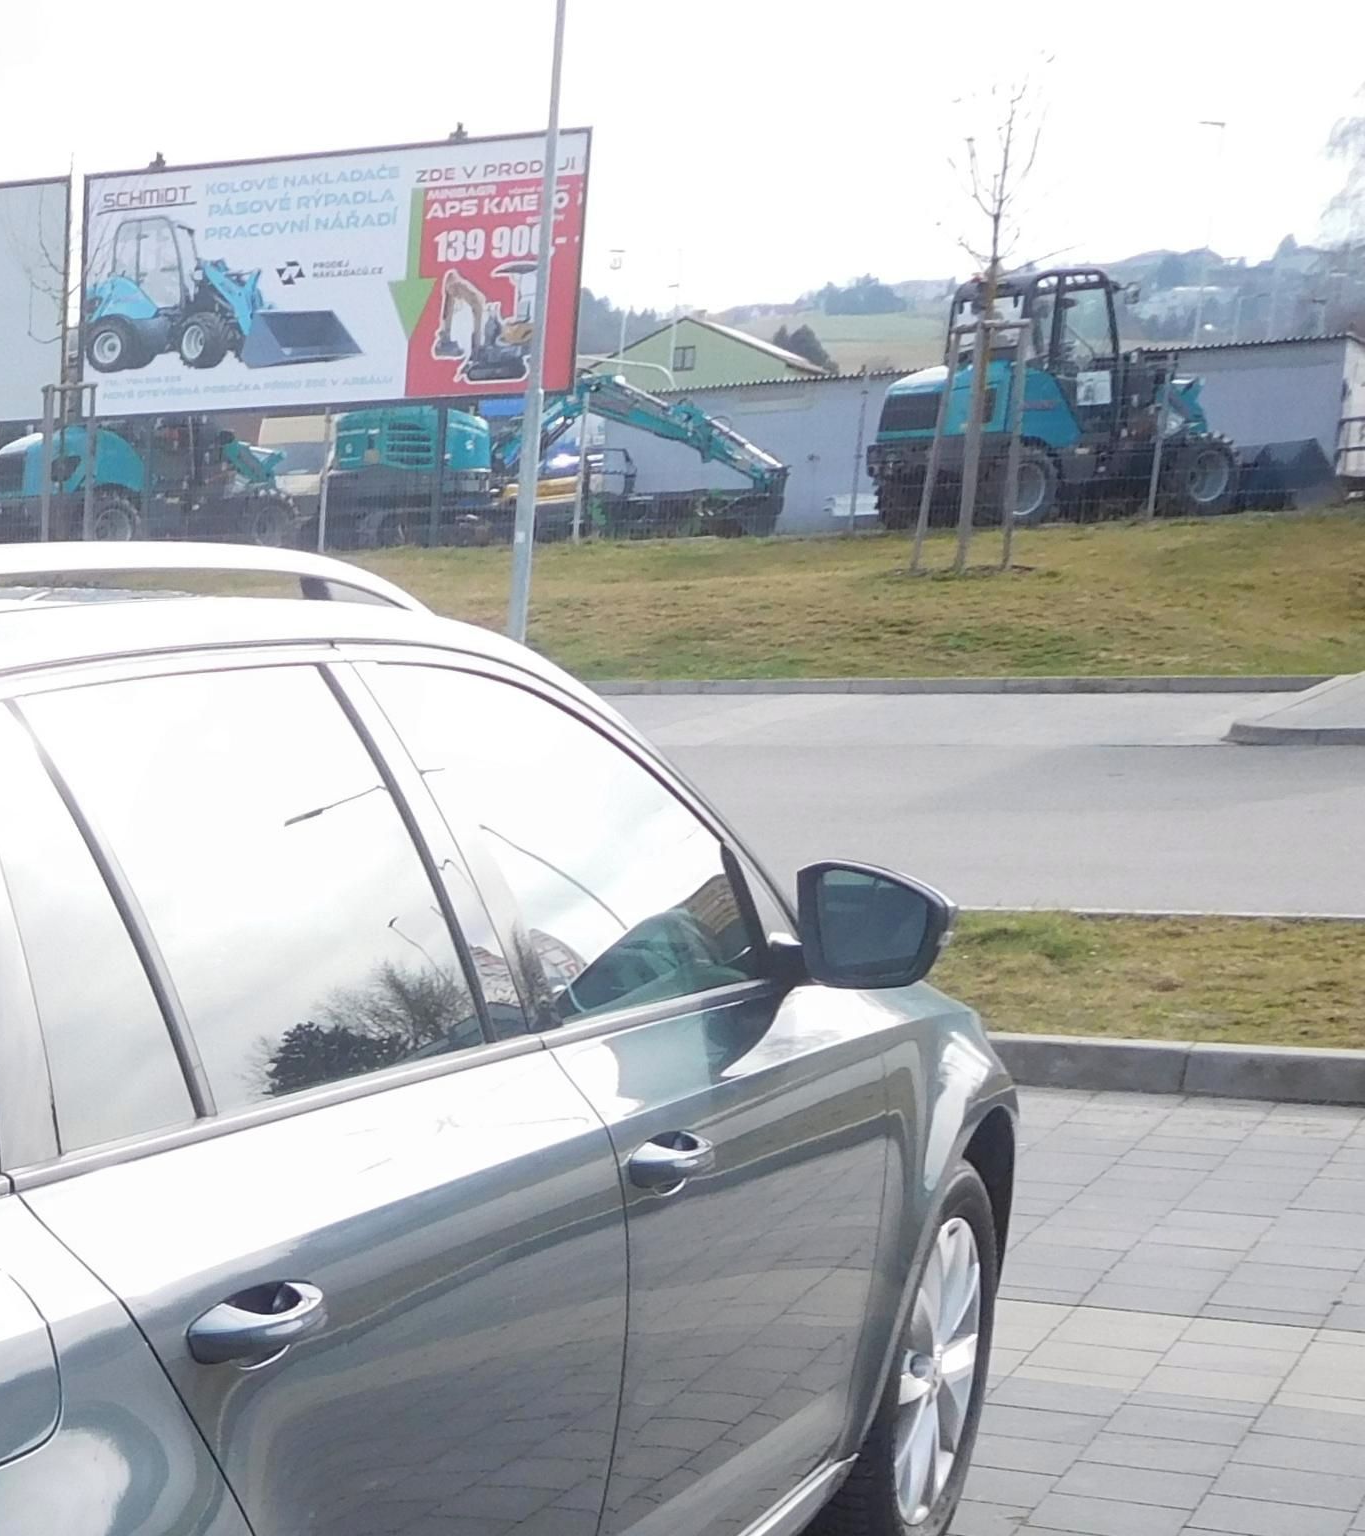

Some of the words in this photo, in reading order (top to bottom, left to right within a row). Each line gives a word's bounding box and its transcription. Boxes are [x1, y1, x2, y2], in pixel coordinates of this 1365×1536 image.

[206, 174, 279, 196] KOLOVÉ
[283, 166, 400, 189] NAKLADAČE
[416, 168, 455, 183] ZDE
[463, 166, 477, 179] V
[484, 157, 575, 178] PRODJI
[208, 195, 290, 217] PÁSOVÉ
[297, 188, 395, 210] RÝPADLA
[426, 199, 478, 219] APS
[483, 191, 569, 215] KMEO
[204, 217, 310, 240] PRACOVNÍ
[315, 207, 398, 231] NÁŘADÍ
[434, 228, 485, 262] 139
